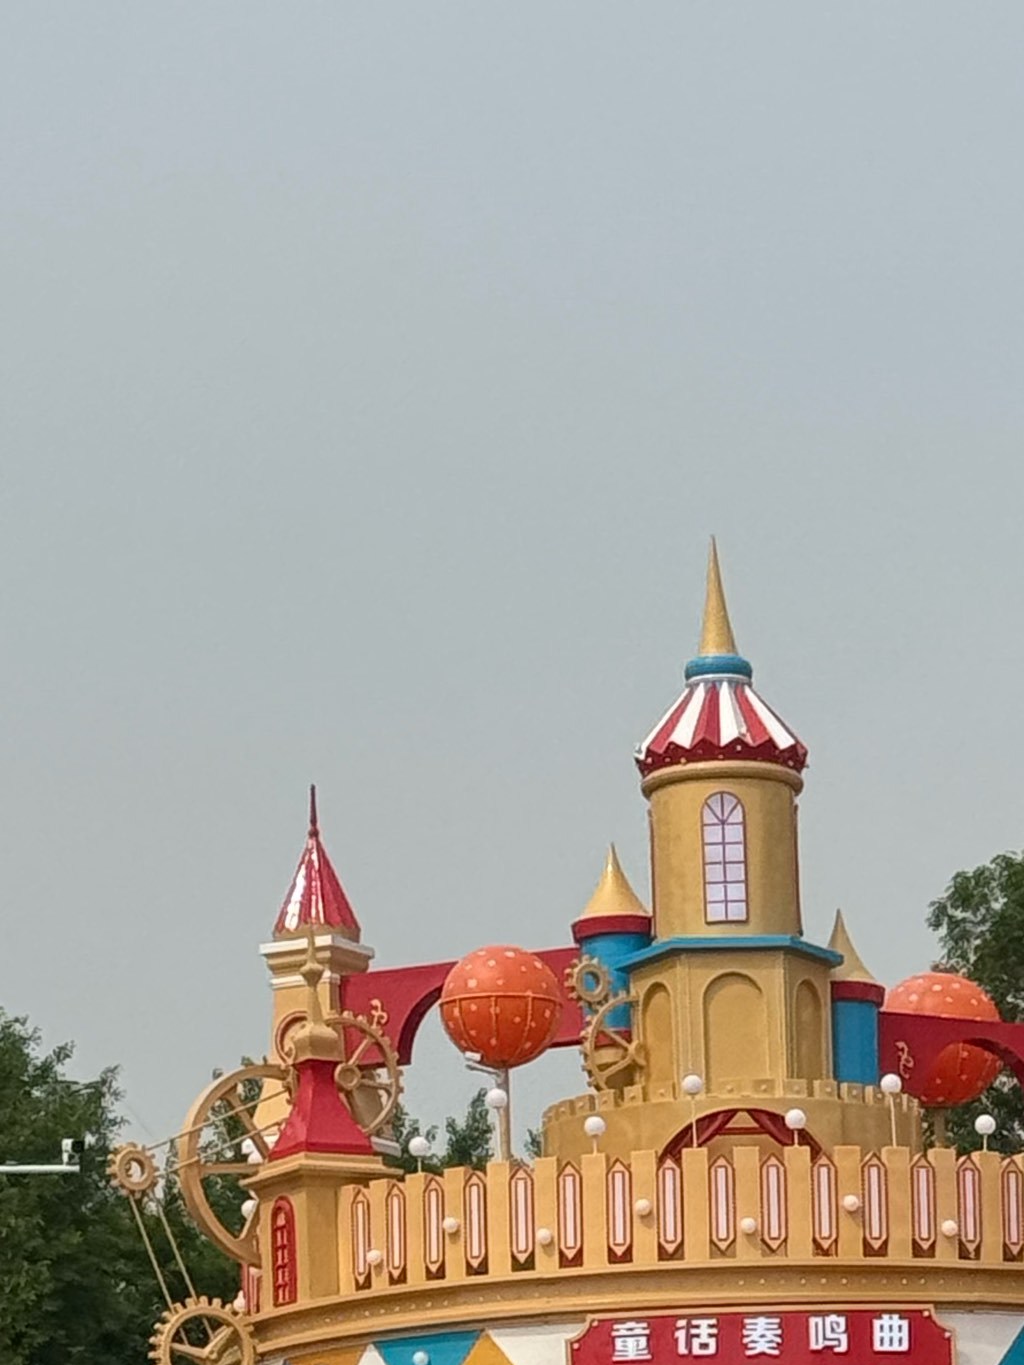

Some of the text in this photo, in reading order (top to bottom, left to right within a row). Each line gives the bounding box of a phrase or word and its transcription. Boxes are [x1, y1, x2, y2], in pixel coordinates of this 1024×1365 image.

[611, 1313, 911, 1363] 童话奏鸣曲
